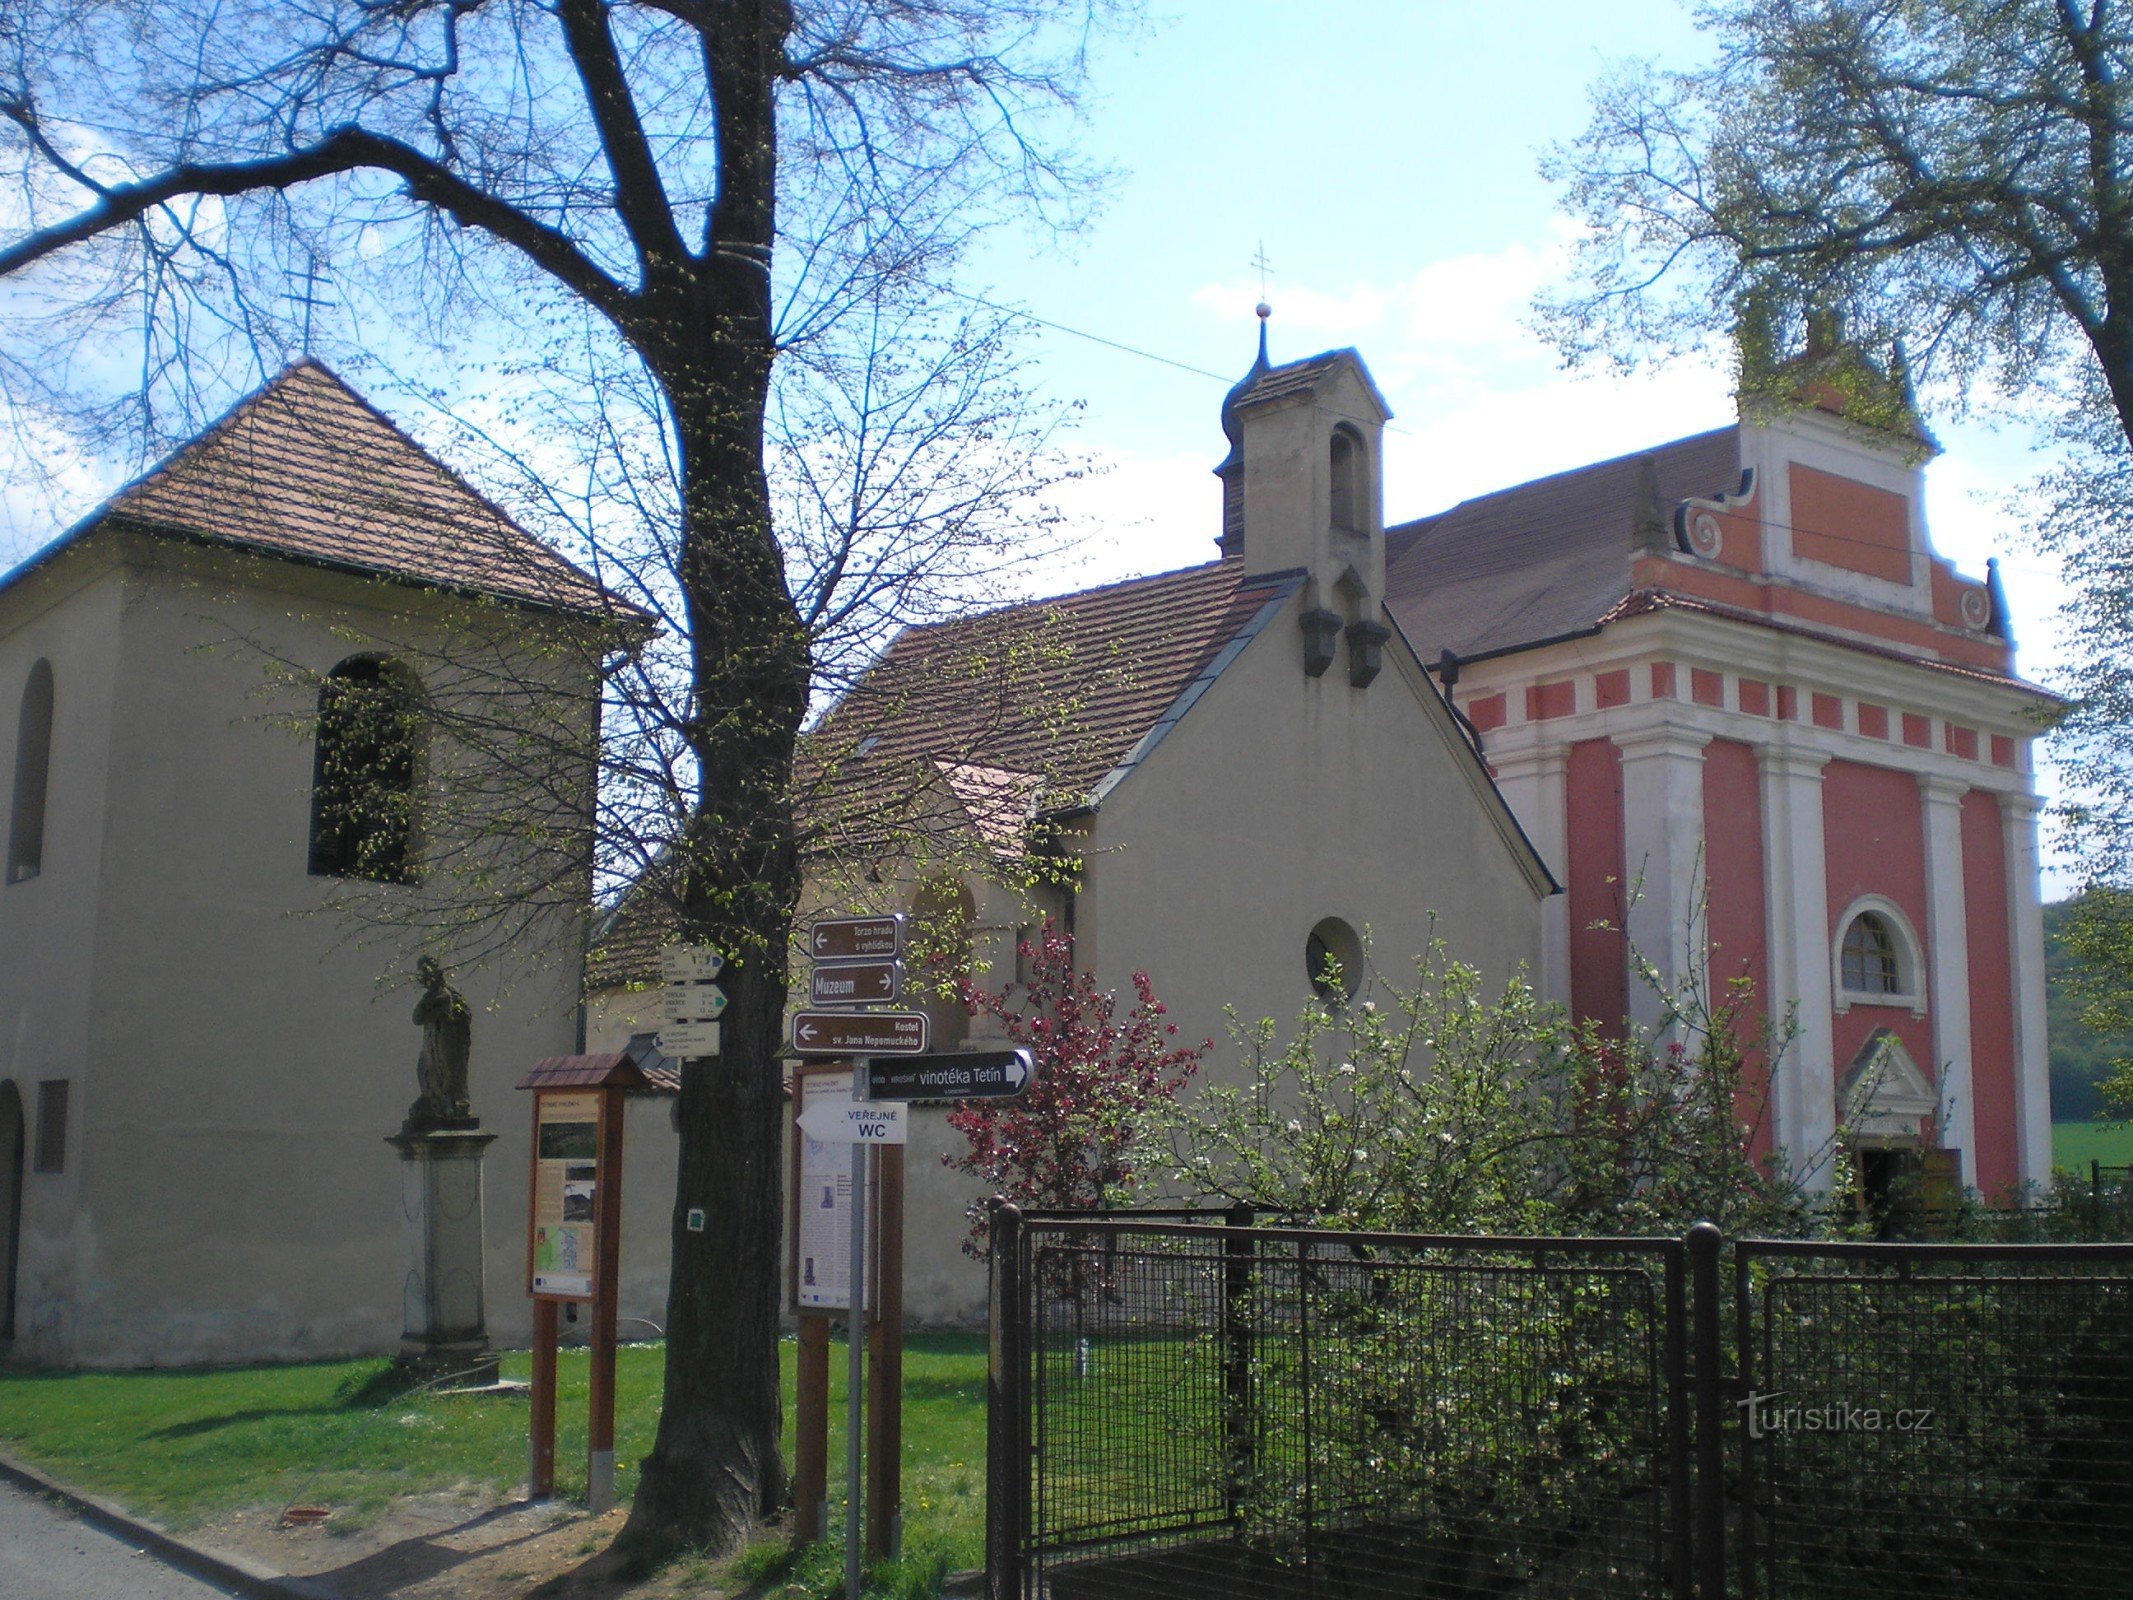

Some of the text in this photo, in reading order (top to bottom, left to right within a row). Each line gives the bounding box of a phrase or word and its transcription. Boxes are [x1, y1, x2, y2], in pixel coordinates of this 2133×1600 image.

[854, 925, 893, 936] Torzo hradu
[815, 977, 855, 995] Muzeum
[895, 1022, 919, 1032] Kostel
[832, 1035, 918, 1047] sv. Jana Nepomuckého
[919, 1068, 970, 1085] vinotéka
[973, 1066, 1001, 1083] Tetín
[848, 1110, 897, 1121] VEŘEJNÉ
[858, 1124, 886, 1138] WC
